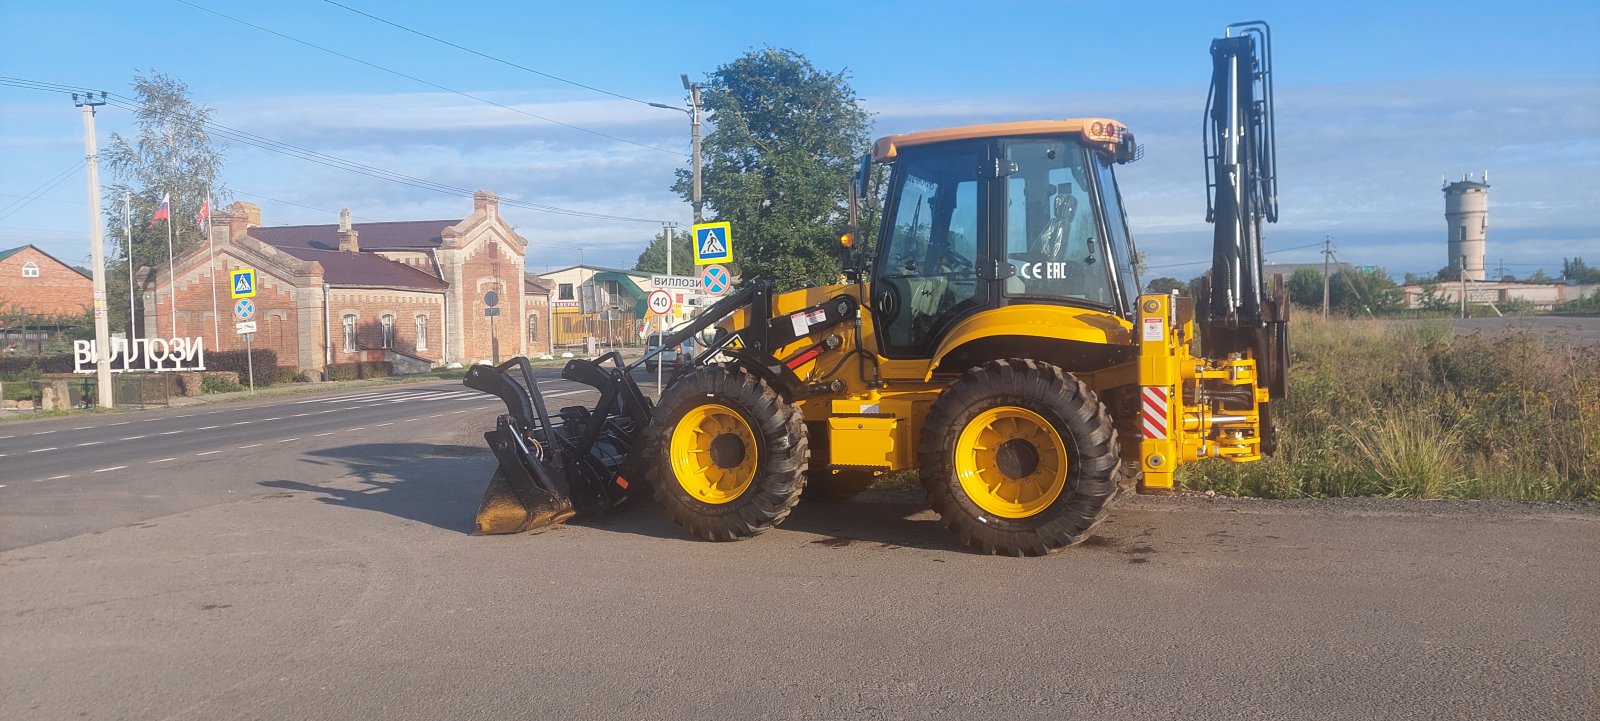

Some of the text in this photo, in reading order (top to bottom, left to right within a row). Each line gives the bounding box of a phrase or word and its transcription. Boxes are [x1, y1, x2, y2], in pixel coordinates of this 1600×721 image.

[1021, 262, 1042, 279] CE
[654, 277, 702, 288] ВИЛЛОЗИ
[653, 297, 668, 307] 40
